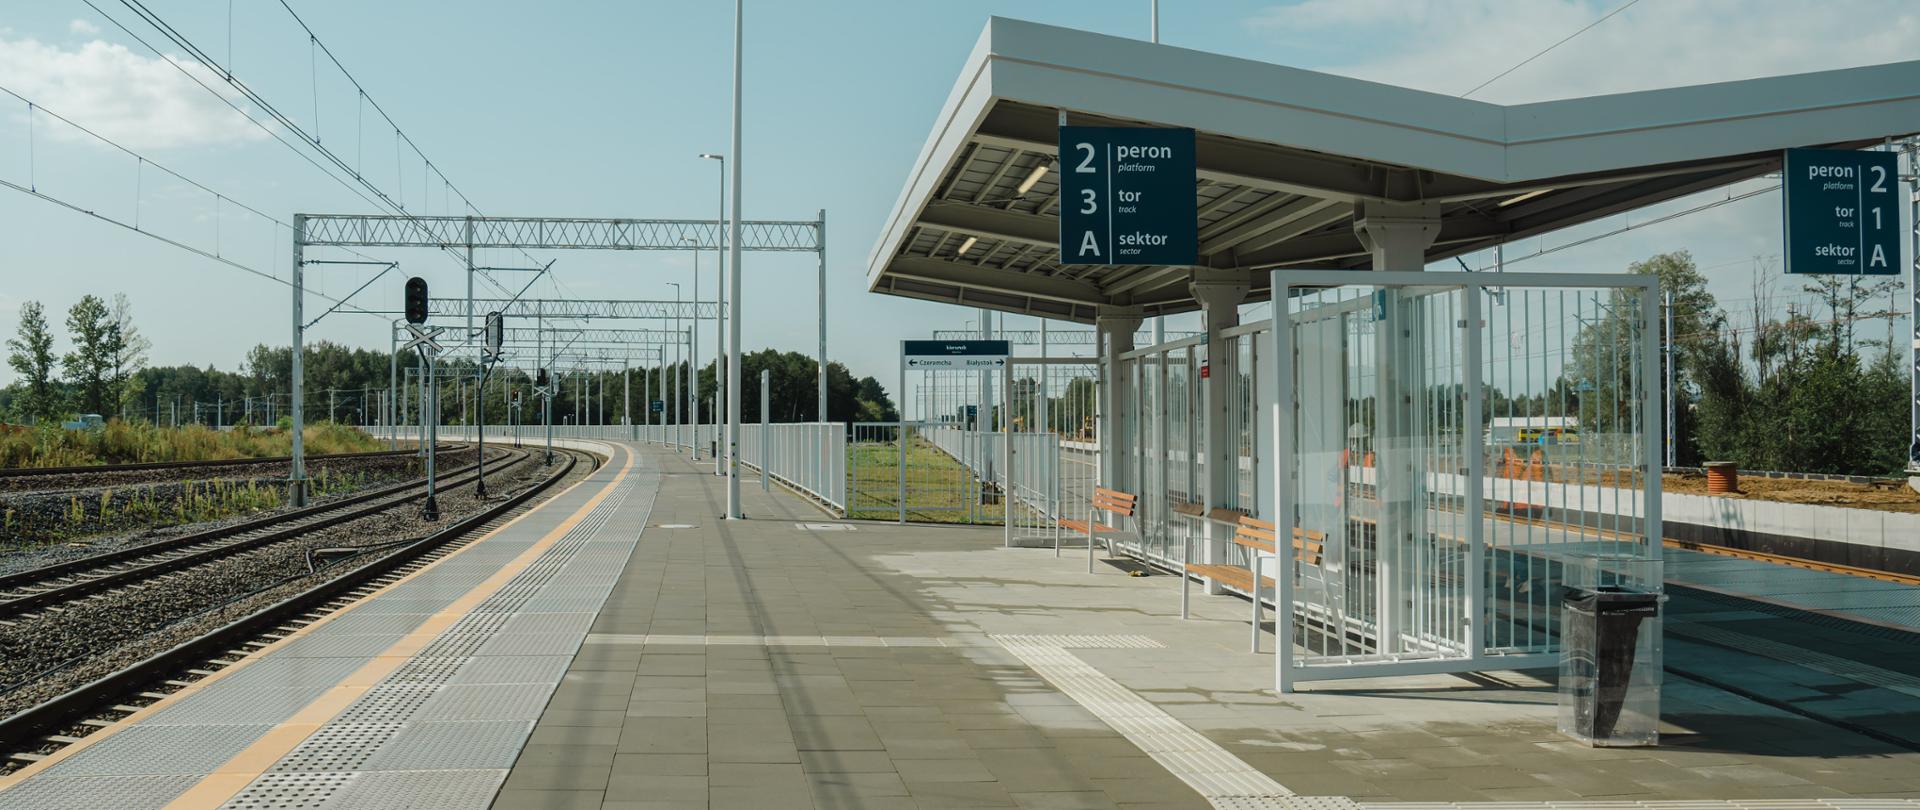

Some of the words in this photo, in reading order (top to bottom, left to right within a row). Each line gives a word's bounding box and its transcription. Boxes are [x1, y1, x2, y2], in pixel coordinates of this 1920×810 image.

[1075, 142, 1096, 173] 2
[1117, 145, 1172, 161] peron
[1118, 162, 1155, 174] platform
[1809, 165, 1853, 180] peron
[1870, 165, 1887, 193] 2
[1823, 181, 1854, 191] platform
[1080, 188, 1097, 215] 3
[1118, 189, 1142, 202] tor
[1118, 205, 1137, 213] track
[1835, 206, 1854, 218] tor
[1872, 206, 1882, 230] 1
[1078, 230, 1101, 257] A
[1119, 231, 1168, 246] sektor
[1815, 243, 1856, 257] sektor
[1869, 244, 1888, 268] A
[966, 359, 993, 367] Białystok
